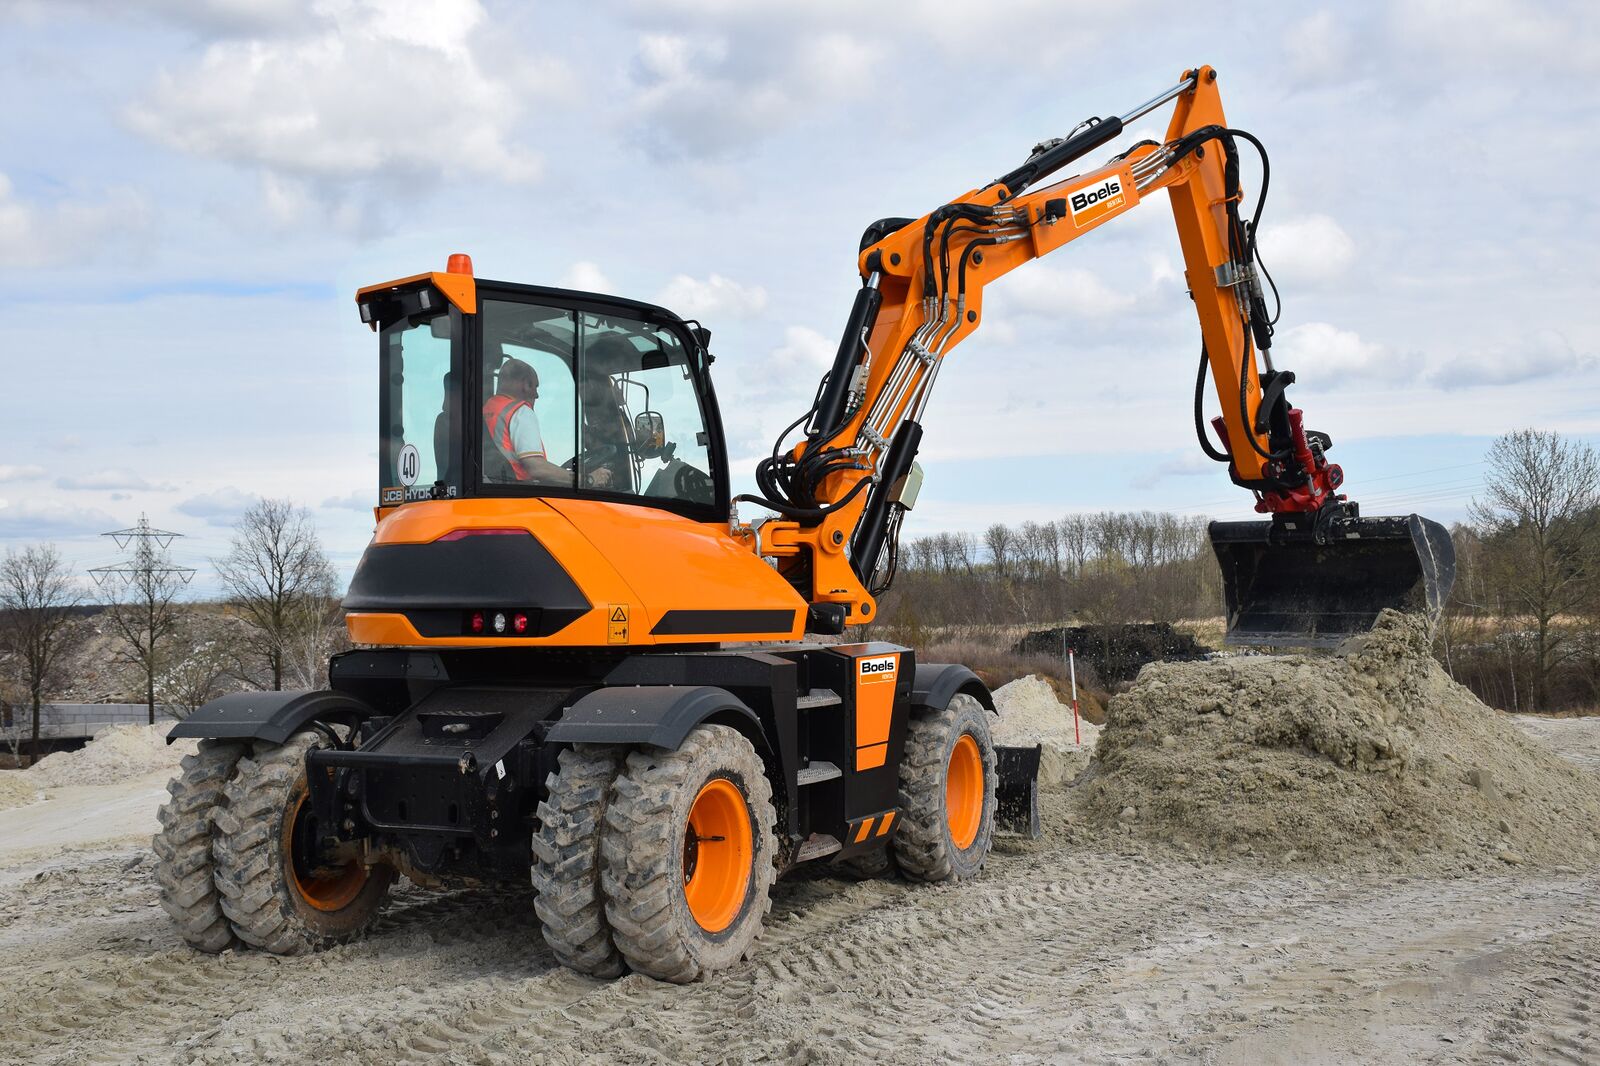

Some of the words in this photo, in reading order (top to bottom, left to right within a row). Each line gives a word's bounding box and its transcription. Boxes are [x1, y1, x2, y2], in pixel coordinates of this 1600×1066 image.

[1071, 182, 1120, 211] Boels
[403, 452, 415, 478] 40
[384, 490, 402, 501] JCB
[862, 660, 894, 673] Boels
